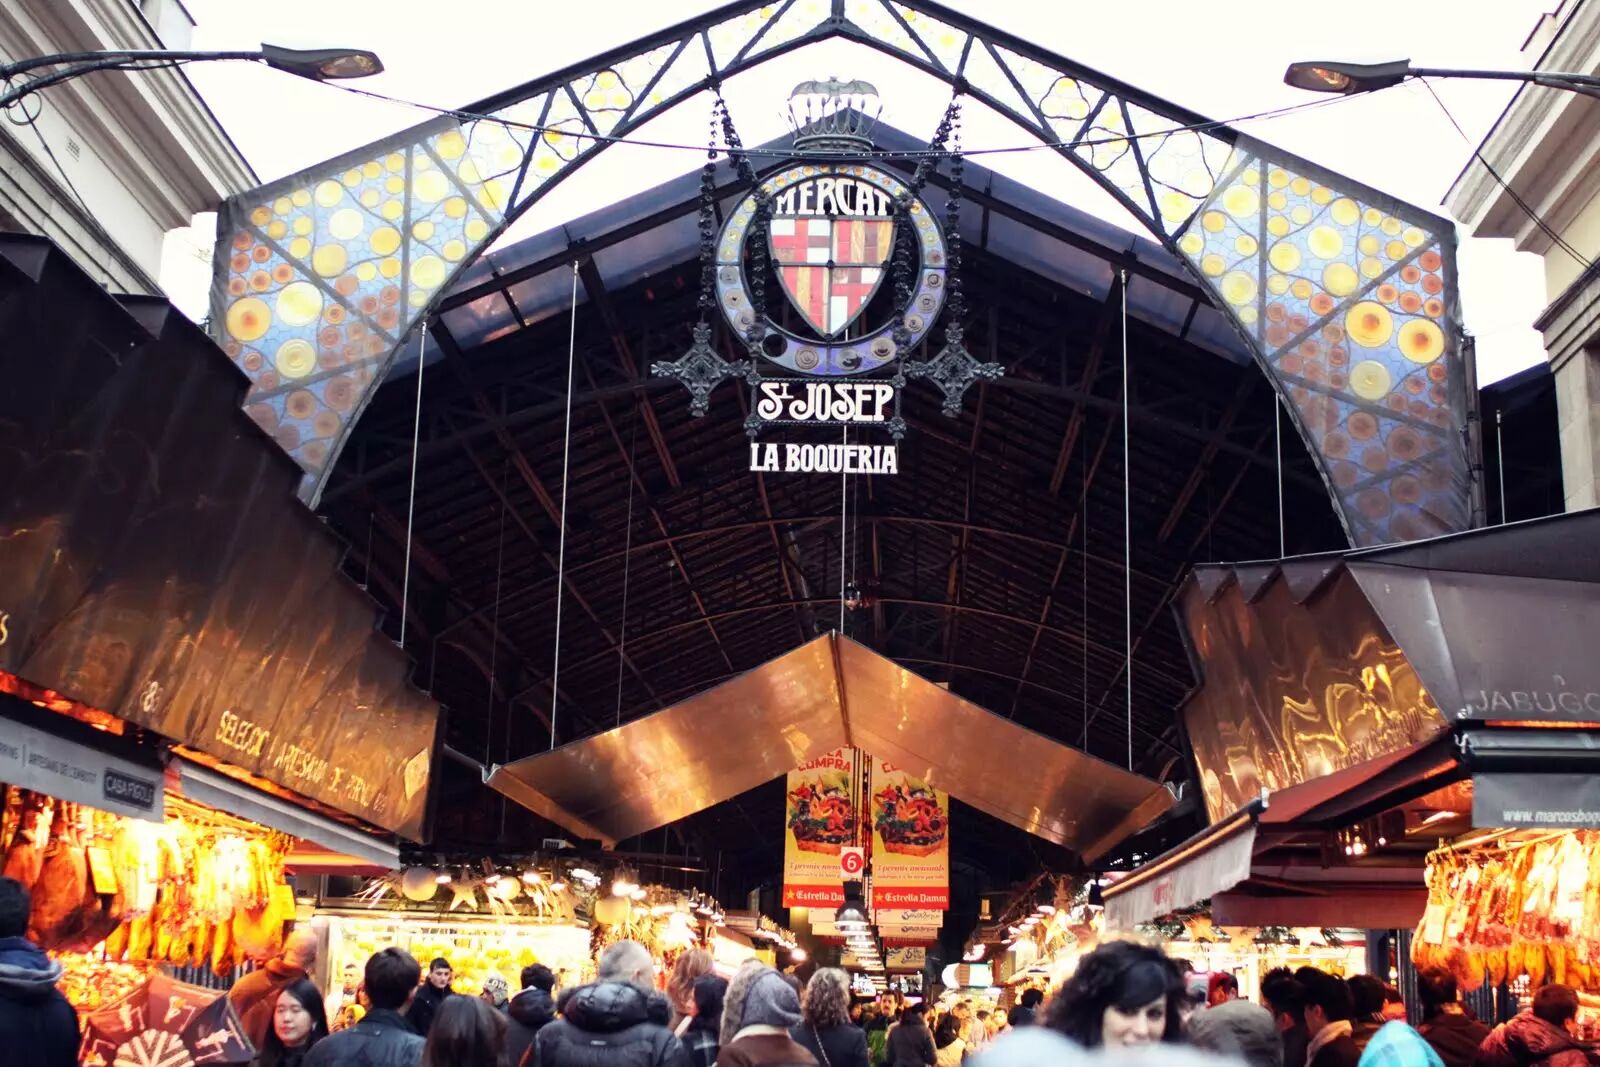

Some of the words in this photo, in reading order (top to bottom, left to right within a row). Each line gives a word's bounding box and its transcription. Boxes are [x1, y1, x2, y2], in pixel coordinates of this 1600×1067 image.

[775, 178, 891, 216] MERCAT
[789, 384, 893, 421] JOSEP
[750, 443, 780, 471] LA
[785, 443, 898, 474] BOQUERIA
[846, 854, 857, 871] 6
[796, 890, 829, 901] Estrella
[831, 891, 845, 902] Da
[884, 892, 919, 903] Estrella
[920, 893, 947, 903] Damm
